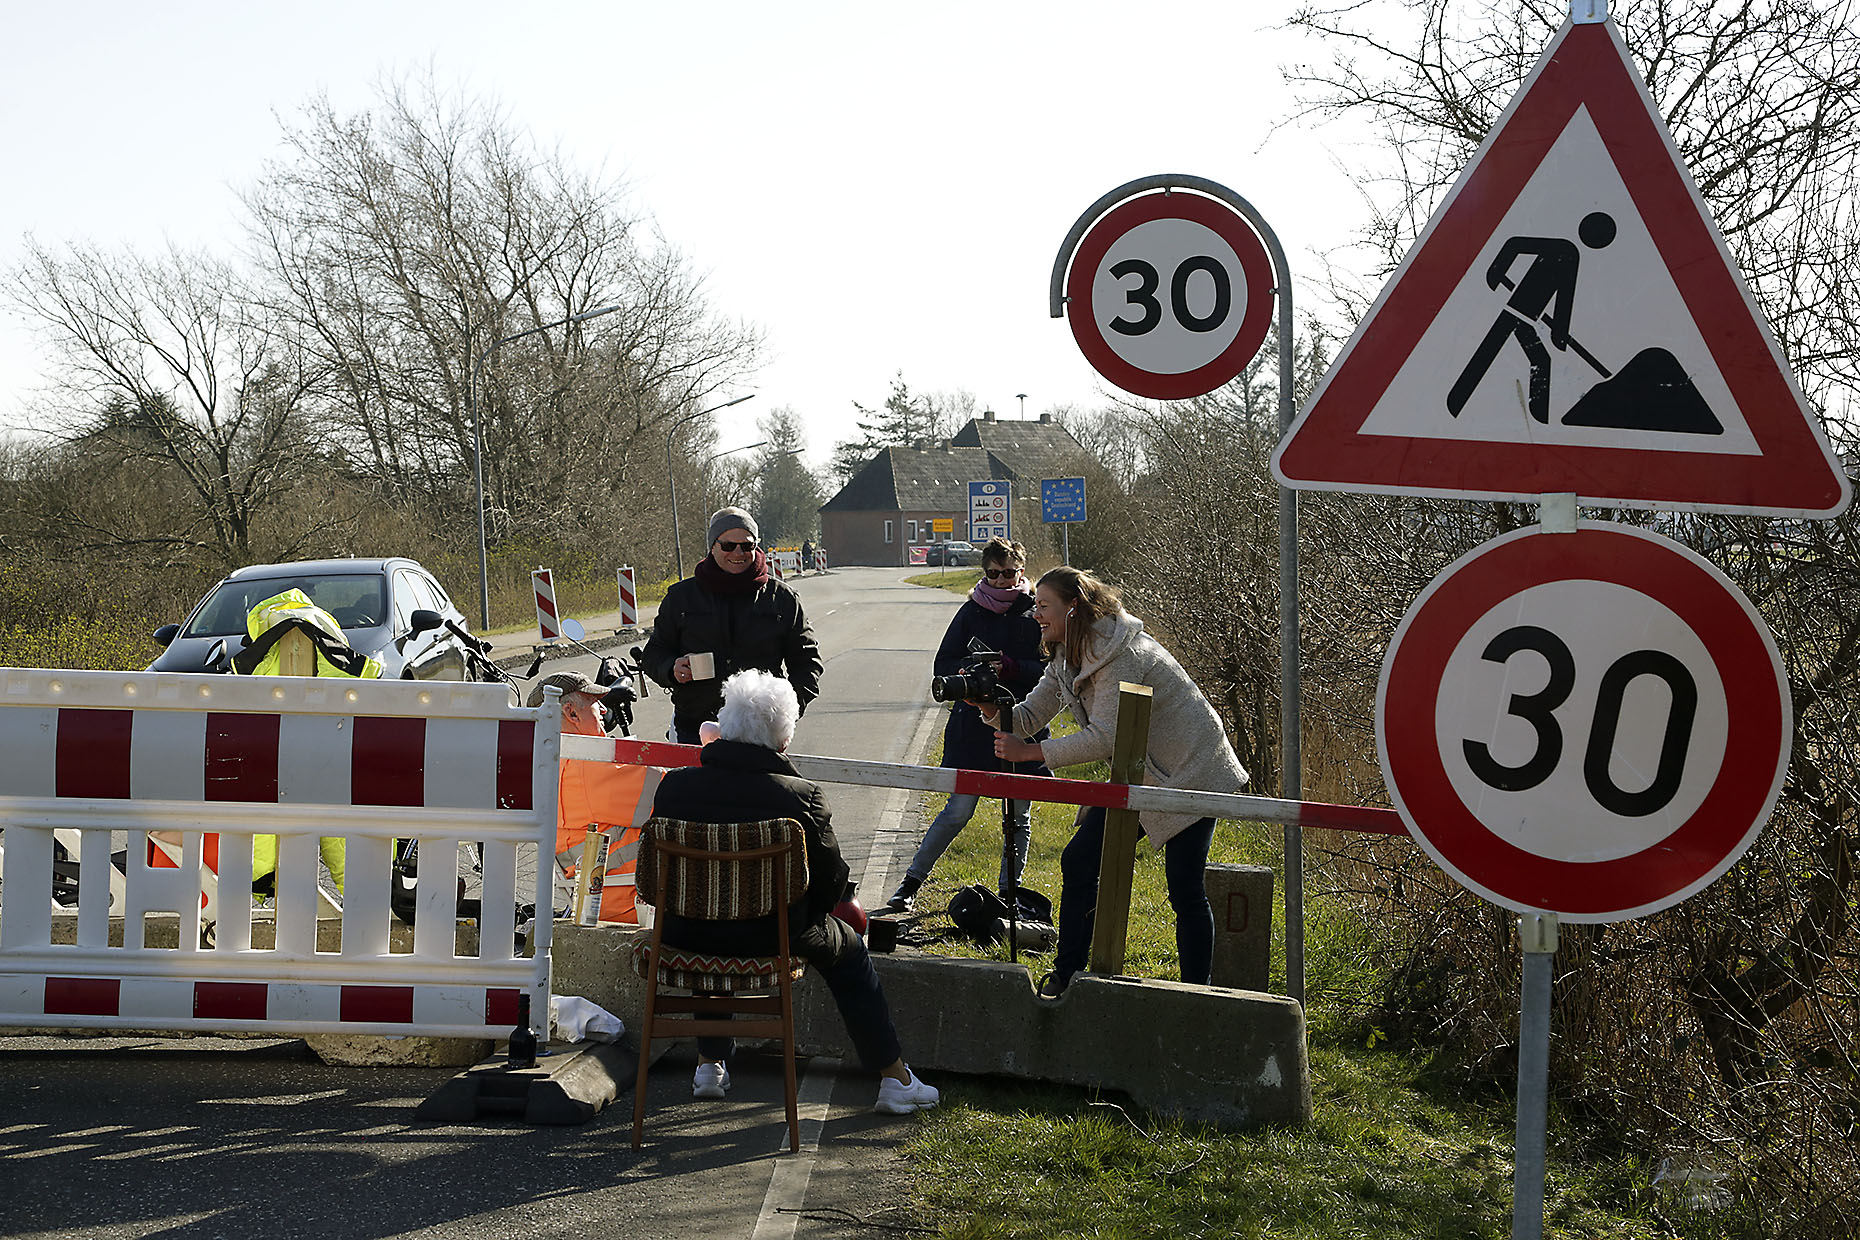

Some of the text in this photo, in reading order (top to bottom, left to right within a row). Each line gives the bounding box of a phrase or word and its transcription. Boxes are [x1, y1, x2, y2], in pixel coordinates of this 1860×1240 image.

[1108, 255, 1231, 336] 30
[986, 485, 993, 493] D
[1462, 625, 1698, 818] 30
[1226, 892, 1248, 932] D
